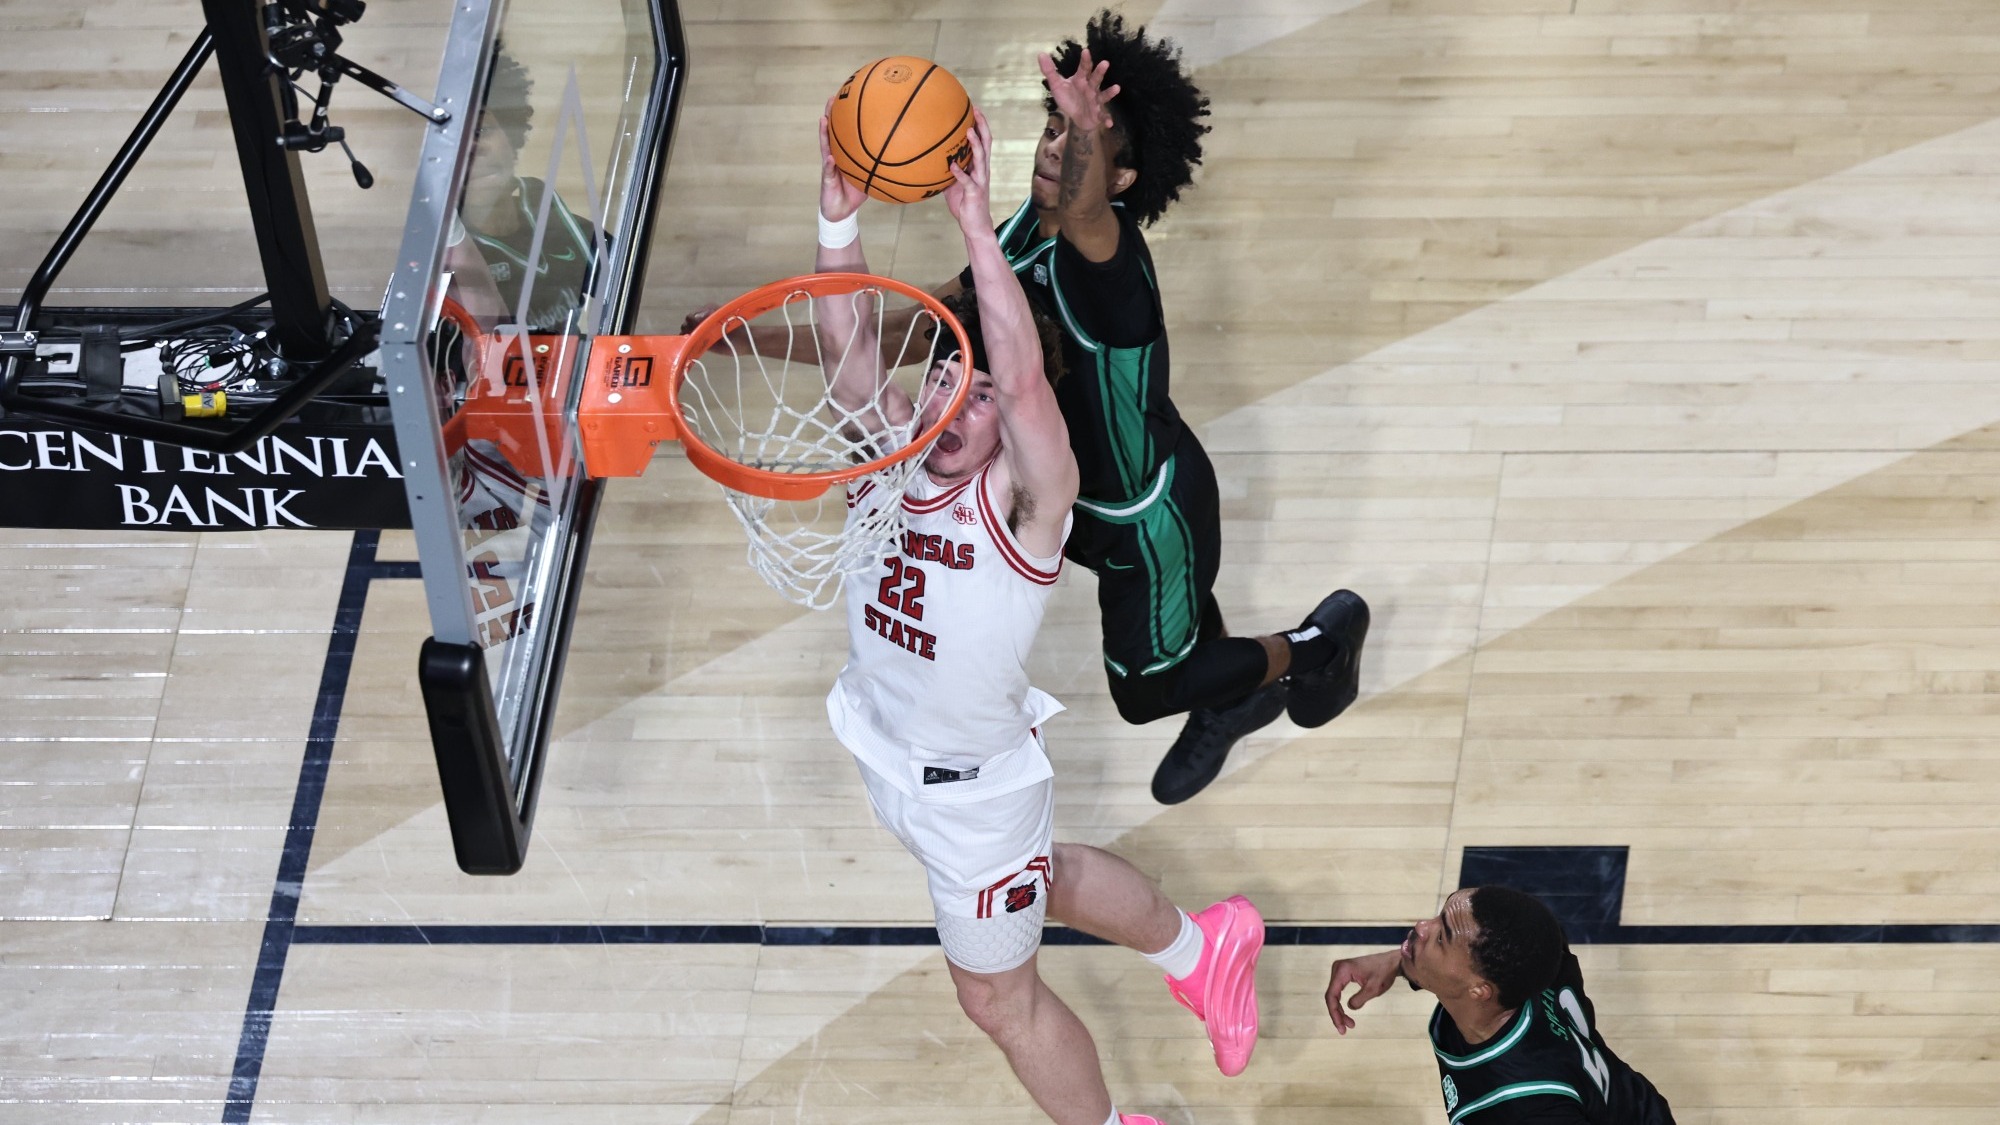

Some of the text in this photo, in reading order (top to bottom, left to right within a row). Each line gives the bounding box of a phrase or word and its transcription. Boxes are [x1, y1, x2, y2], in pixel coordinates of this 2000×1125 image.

[0, 430, 405, 478] CENTENNIA
[114, 484, 317, 527] BANK
[878, 556, 926, 622] 22
[864, 603, 937, 662] STATE
